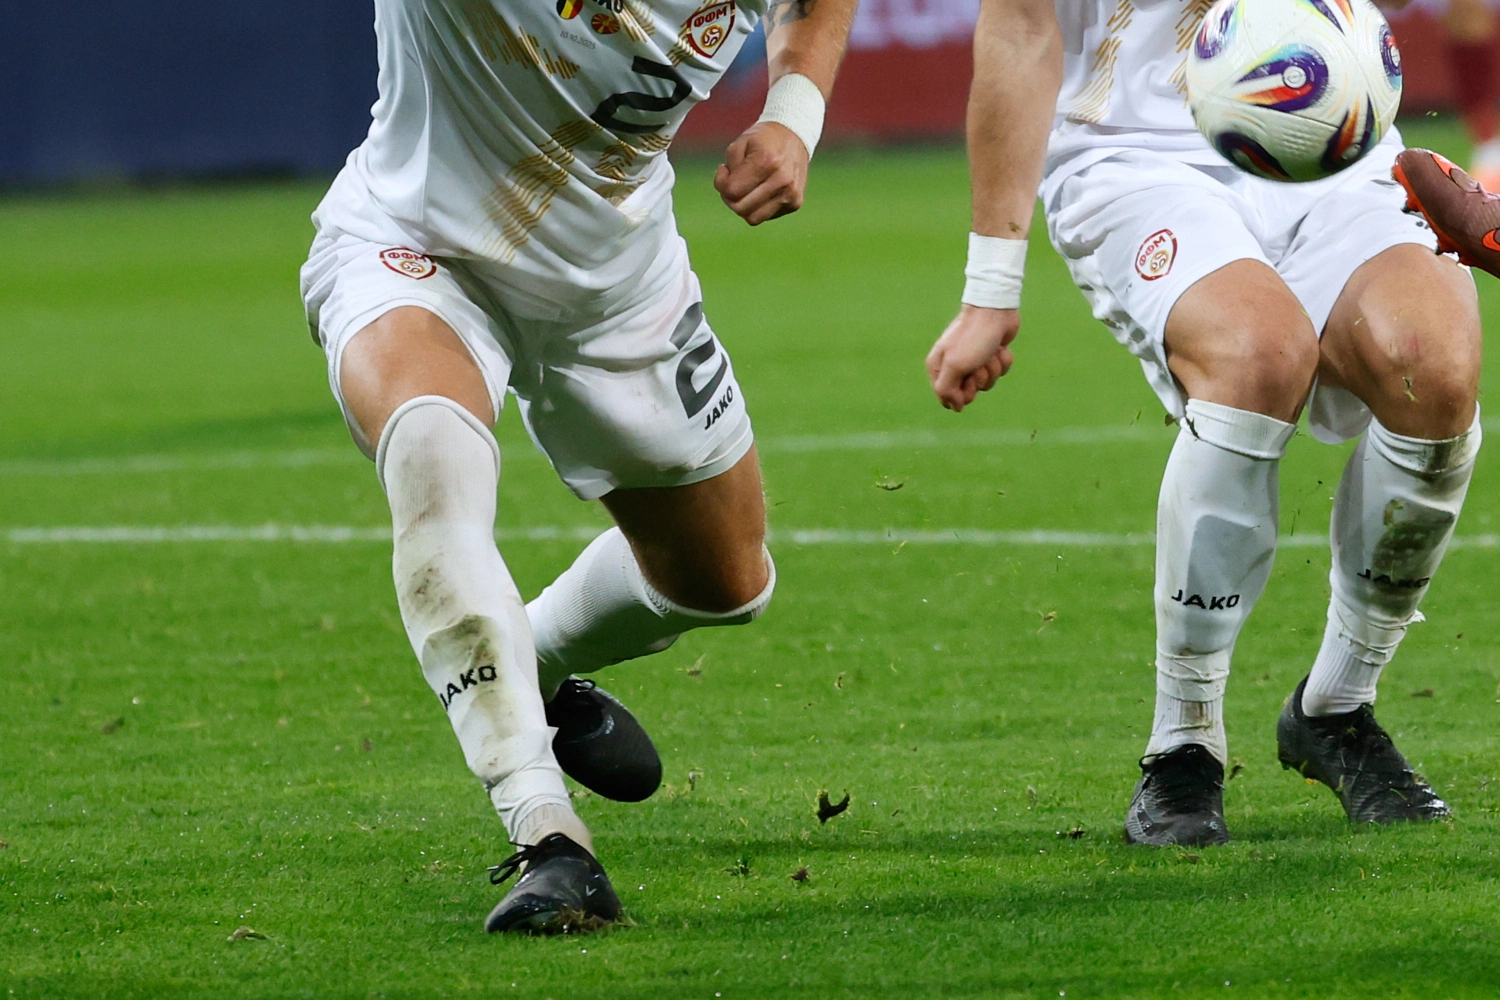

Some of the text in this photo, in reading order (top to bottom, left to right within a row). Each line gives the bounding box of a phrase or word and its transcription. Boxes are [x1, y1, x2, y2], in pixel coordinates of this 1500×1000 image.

[590, 55, 693, 134] 2
[668, 301, 728, 420] 2
[703, 385, 733, 431] JAKO
[1170, 588, 1241, 610] JAKO
